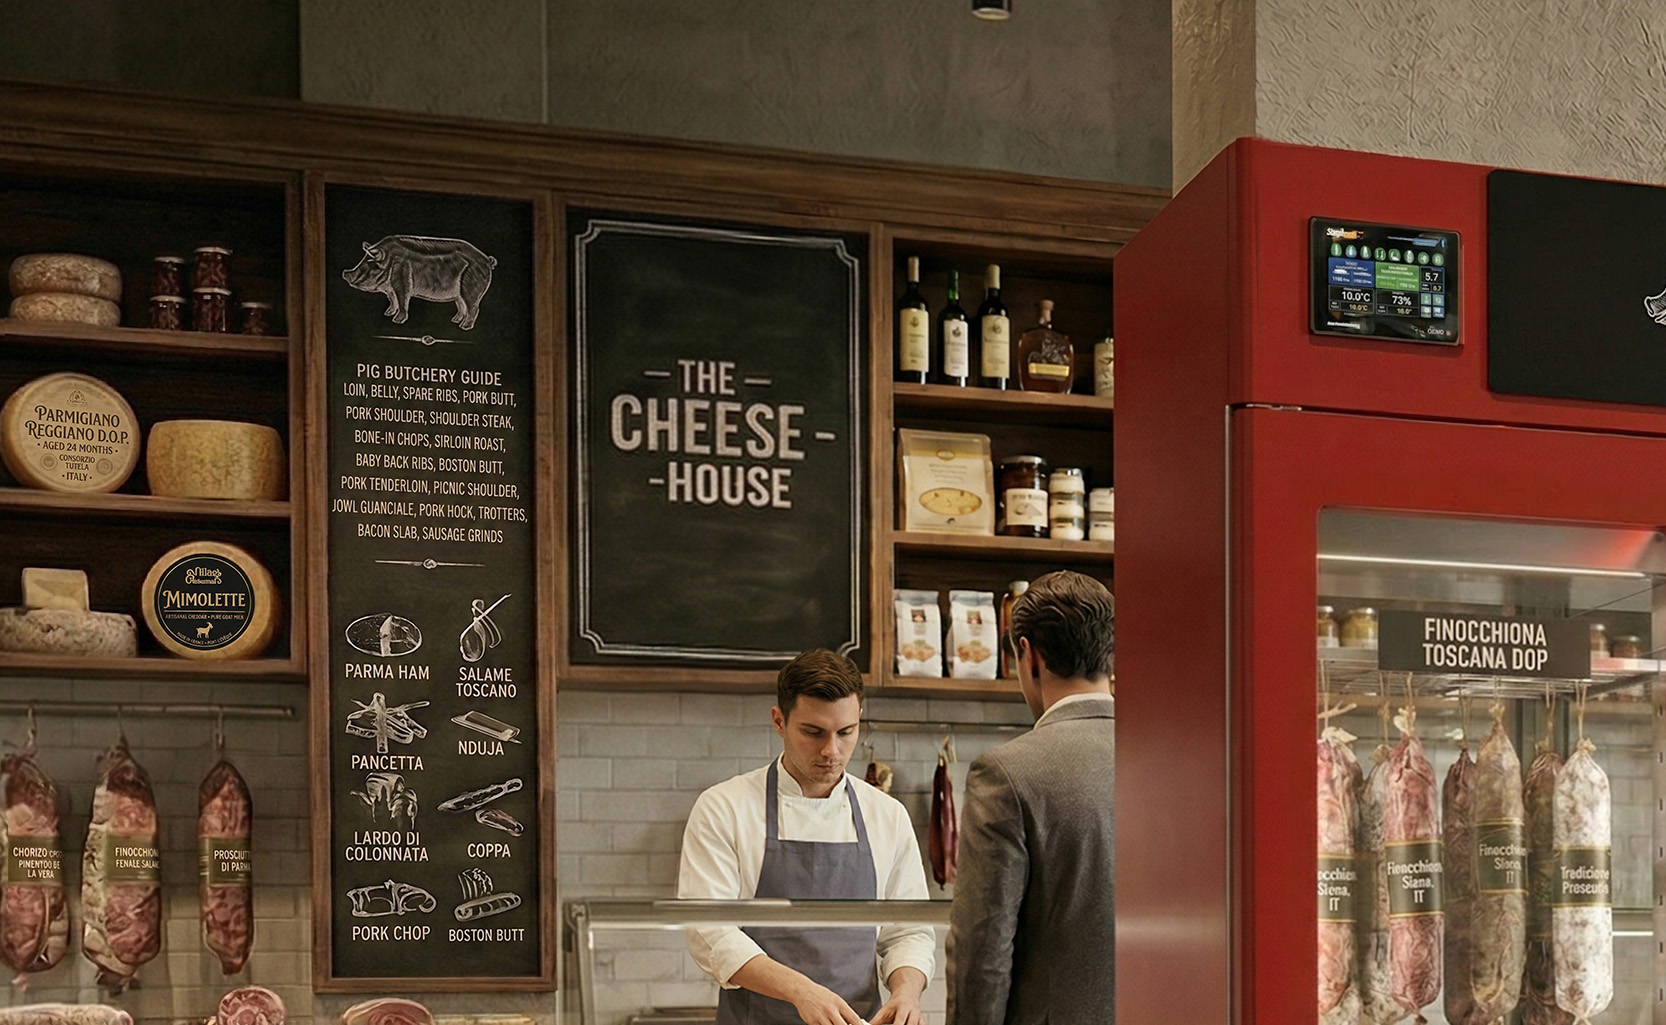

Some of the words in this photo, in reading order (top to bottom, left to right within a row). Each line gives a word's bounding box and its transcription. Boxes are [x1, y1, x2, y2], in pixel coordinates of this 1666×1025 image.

[1392, 295, 1412, 306] 73%
[357, 363, 381, 379] PIG
[385, 365, 456, 383] BUTCHERY
[461, 370, 502, 386] GUIDE
[677, 359, 736, 395] THE
[343, 383, 369, 398] LOIN,
[371, 384, 401, 401] BELLY,
[403, 387, 434, 401] SPARE
[436, 389, 461, 404] RIBS,
[463, 391, 489, 405] PORK
[490, 392, 517, 408] BUTT,
[35, 405, 120, 428] PARMIGIANO
[345, 406, 372, 420] PORK
[374, 407, 427, 426] SHOULDER,
[429, 411, 480, 427] SHOULDER
[482, 415, 515, 431] STEAK,
[25, 420, 94, 441] REGGIANO
[98, 429, 129, 445] D.O.P.
[611, 394, 805, 460] CHEESE
[42, 441, 65, 451] AGED
[67, 443, 77, 452] 24
[79, 444, 113, 455] MONTHS
[354, 430, 395, 445] BONE-IN
[397, 432, 432, 449] CHOPS,
[434, 435, 472, 449] SIRLOIN
[474, 437, 506, 454] ROAST,
[59, 454, 95, 464] CONSORZIO
[65, 462, 89, 470] TUTELA
[356, 453, 381, 467] BABY
[383, 455, 410, 469] BACK
[411, 456, 437, 472] RIBS,
[439, 458, 477, 473] BOSTON
[479, 460, 505, 476] BUTT,
[66, 472, 88, 481] ITALY
[341, 476, 367, 490] PORK
[369, 477, 431, 496] TENDERLOIN,
[433, 481, 465, 495] PICNIC
[467, 483, 520, 500] SHOULDER,
[332, 499, 358, 513] JOWL
[360, 500, 417, 518] GUANCIALE,
[419, 503, 445, 517] PORK
[447, 505, 476, 521] HOCK,
[478, 506, 528, 523] TROTTERS,
[358, 523, 391, 538] BACON
[393, 525, 420, 542] SLAB,
[422, 527, 466, 542] SAUSAGE
[467, 529, 504, 544] GRINDS
[162, 590, 246, 609] MIMOLETTE
[1424, 617, 1547, 647] FINOCCHIONA
[1422, 643, 1507, 669] TOSCANA
[1511, 649, 1548, 672] DOP
[345, 664, 394, 679] PARMA
[398, 665, 430, 680] HAM
[459, 667, 512, 682] SALAME
[455, 683, 517, 698] TOSCANO
[458, 741, 505, 756] NDUJA
[351, 755, 424, 771] PANCETTA
[354, 831, 401, 846] LARDO
[406, 832, 420, 846] DI
[13, 846, 48, 857] CHORIZO
[345, 847, 429, 862] COLONNATA
[467, 843, 511, 858] COPPA
[27, 870, 37, 878] LA
[38, 870, 55, 879] VERA
[221, 862, 229, 872] DI
[352, 926, 389, 941] PORK
[393, 926, 431, 941] CHOP
[448, 929, 493, 942] BOSTON
[496, 929, 525, 942] BUTT
